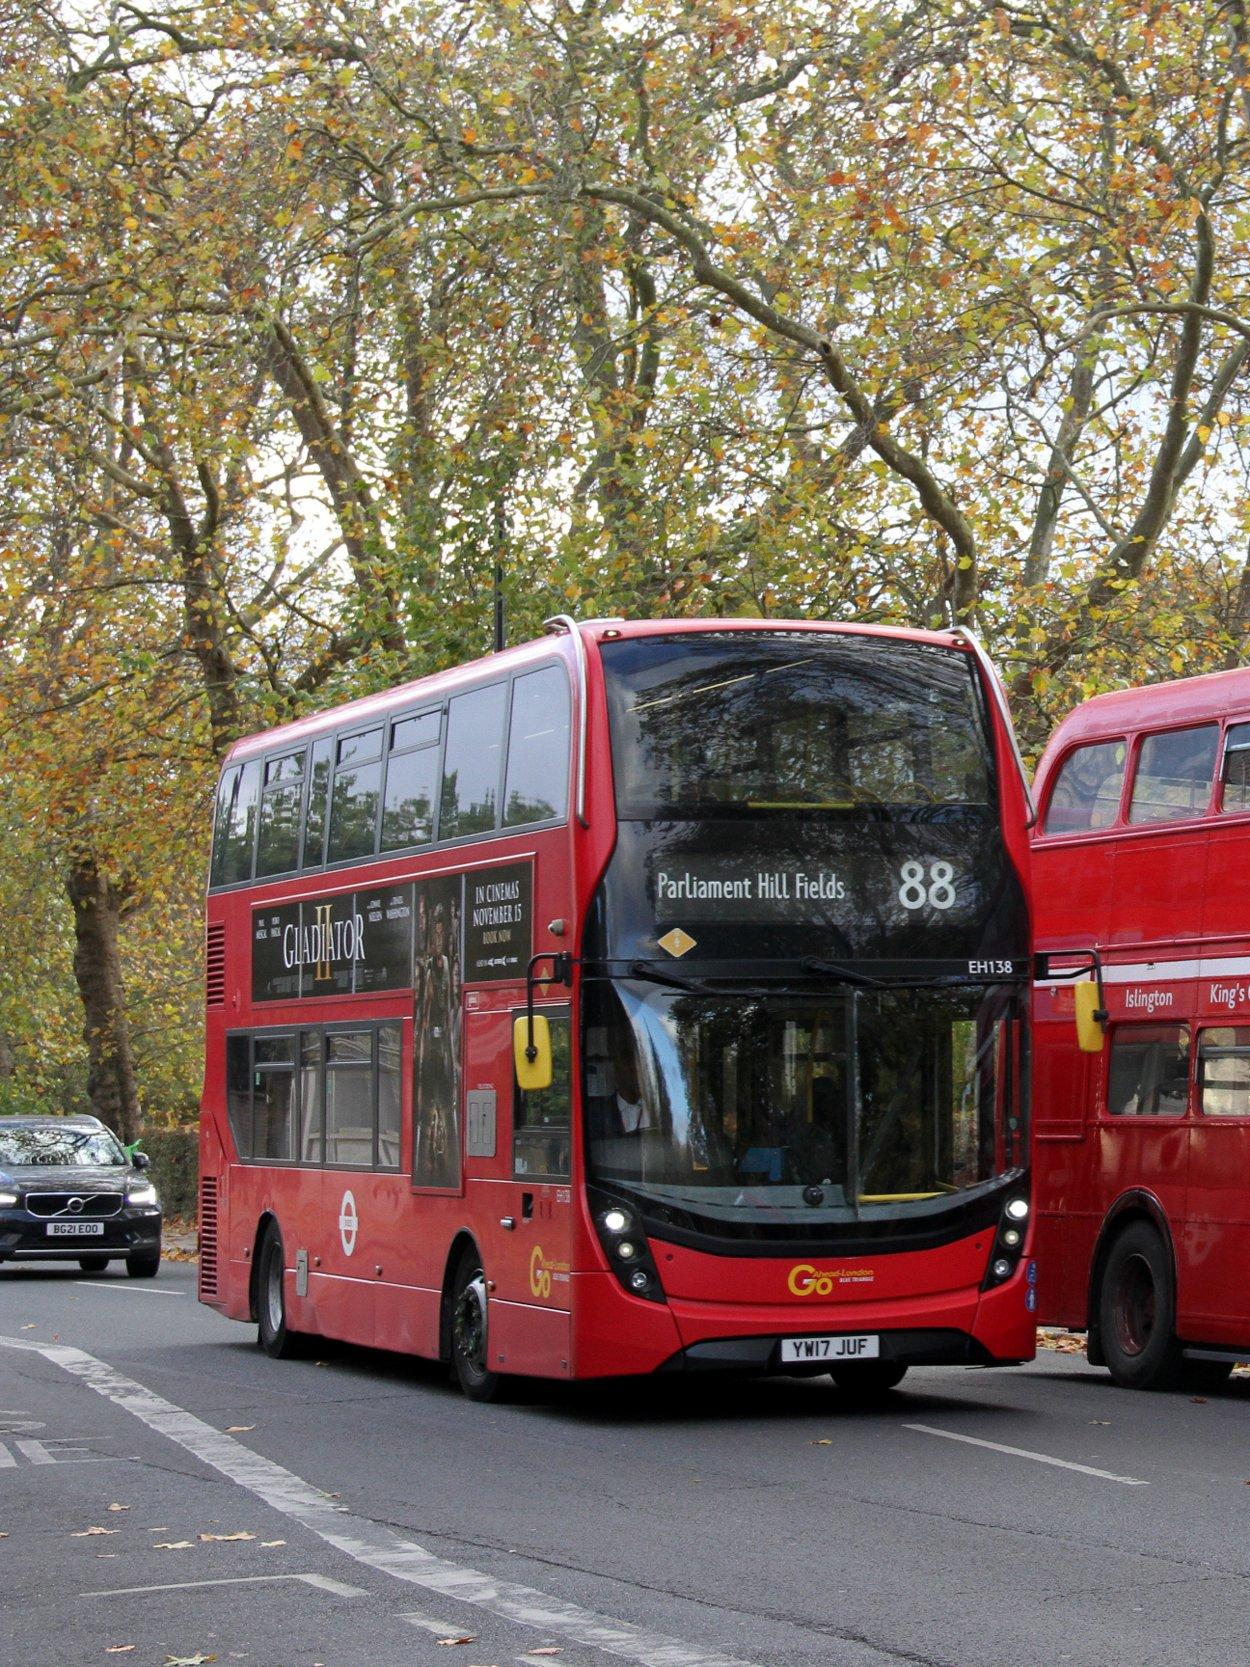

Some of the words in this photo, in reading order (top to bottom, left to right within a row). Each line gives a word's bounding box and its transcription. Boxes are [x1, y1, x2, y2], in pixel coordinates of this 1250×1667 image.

[475, 886, 485, 904] IN
[486, 880, 520, 902] CINEMAS
[657, 872, 752, 899] Parliament
[757, 872, 790, 899] Hill
[795, 872, 845, 899] Fields
[899, 860, 957, 910] 88
[473, 904, 513, 927] NOVEMBER
[514, 903, 522, 922] 15
[283, 913, 366, 969] GLADIATOR
[968, 960, 1013, 974] EH138
[1125, 989, 1173, 1013] Islington
[1209, 983, 1245, 1009] King's
[53, 1224, 76, 1234] BG21
[793, 1340, 830, 1357] YW17
[836, 1338, 868, 1355] JUF
